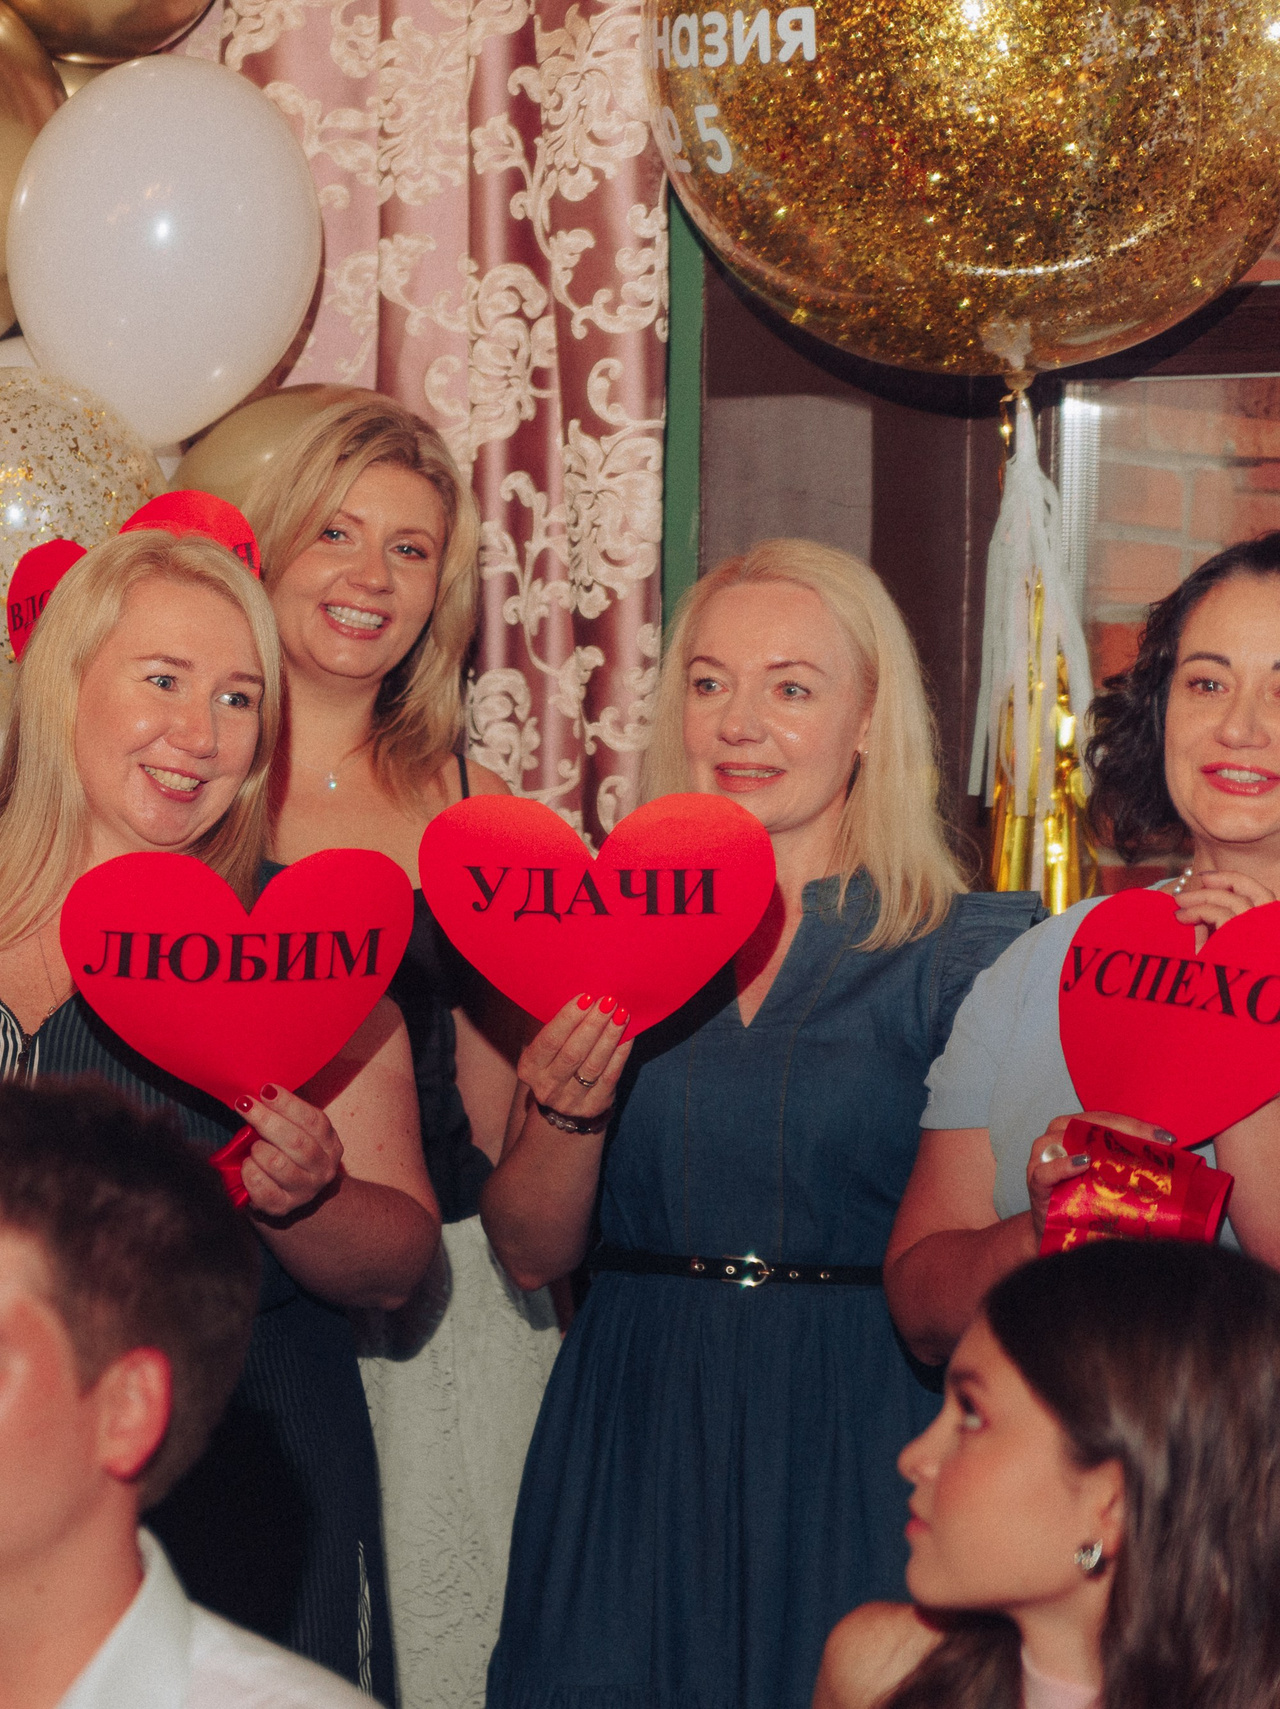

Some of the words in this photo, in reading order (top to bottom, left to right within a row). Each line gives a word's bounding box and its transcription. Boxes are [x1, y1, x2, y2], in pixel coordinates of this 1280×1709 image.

[693, 103, 733, 174] 5
[462, 865, 721, 924] УДАЧИ
[82, 927, 387, 984] ЛЮБИМ
[1062, 945, 1280, 1026] УСПЕХО
